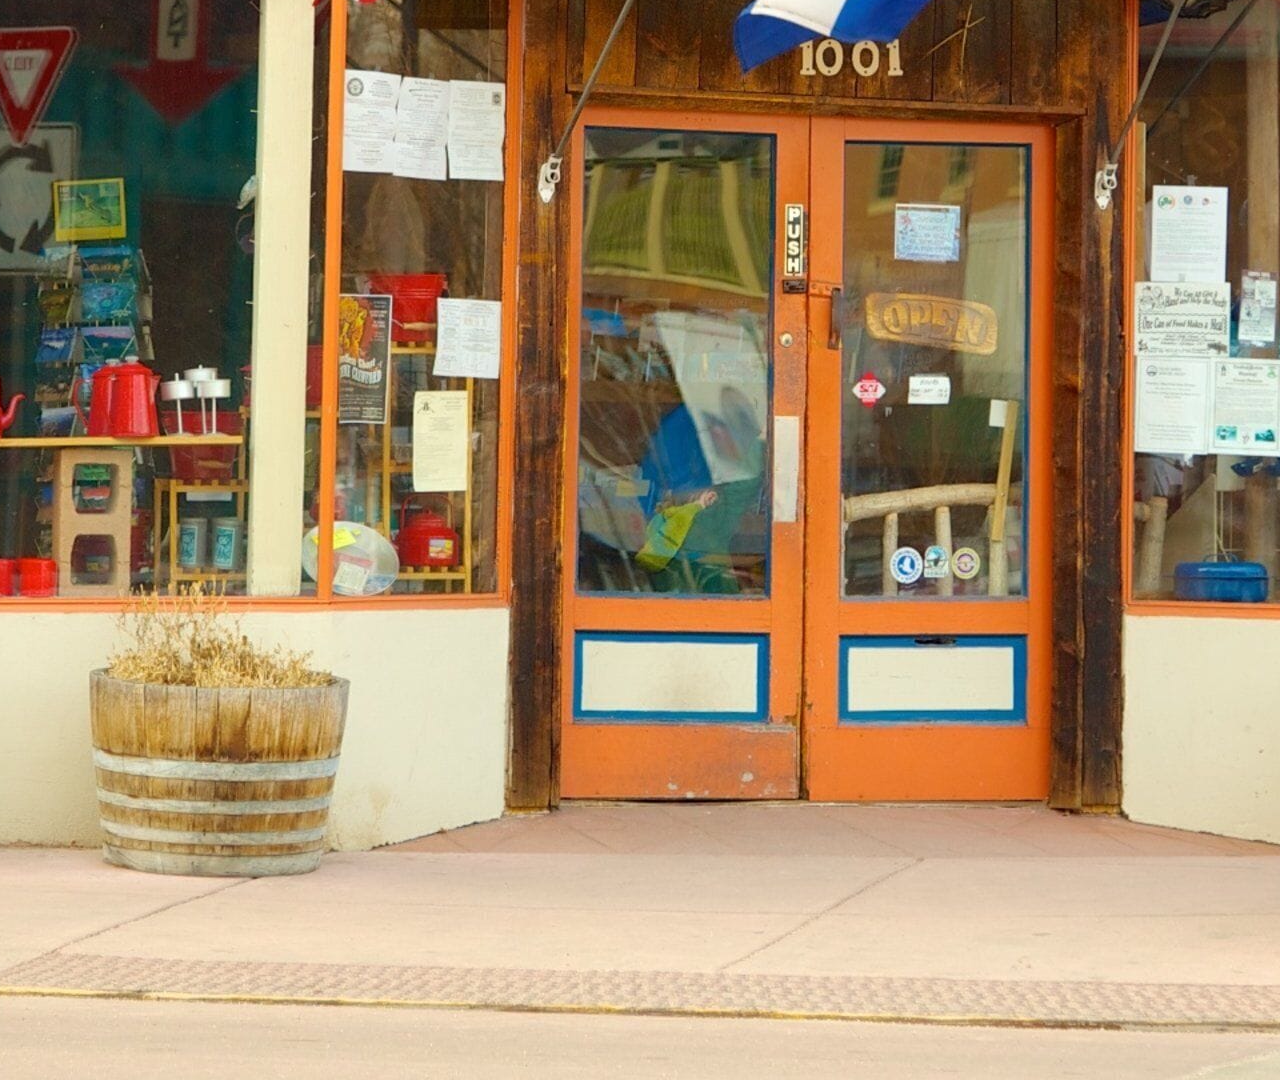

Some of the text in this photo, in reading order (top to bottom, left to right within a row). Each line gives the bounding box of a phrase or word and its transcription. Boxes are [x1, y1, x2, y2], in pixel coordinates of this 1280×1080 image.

[799, 38, 904, 77] 1001
[788, 207, 802, 273] PUSH
[882, 301, 989, 347] OPEN
[1154, 317, 1165, 329] Can
[1172, 319, 1186, 328] Food
[1187, 319, 1204, 329] Makes
